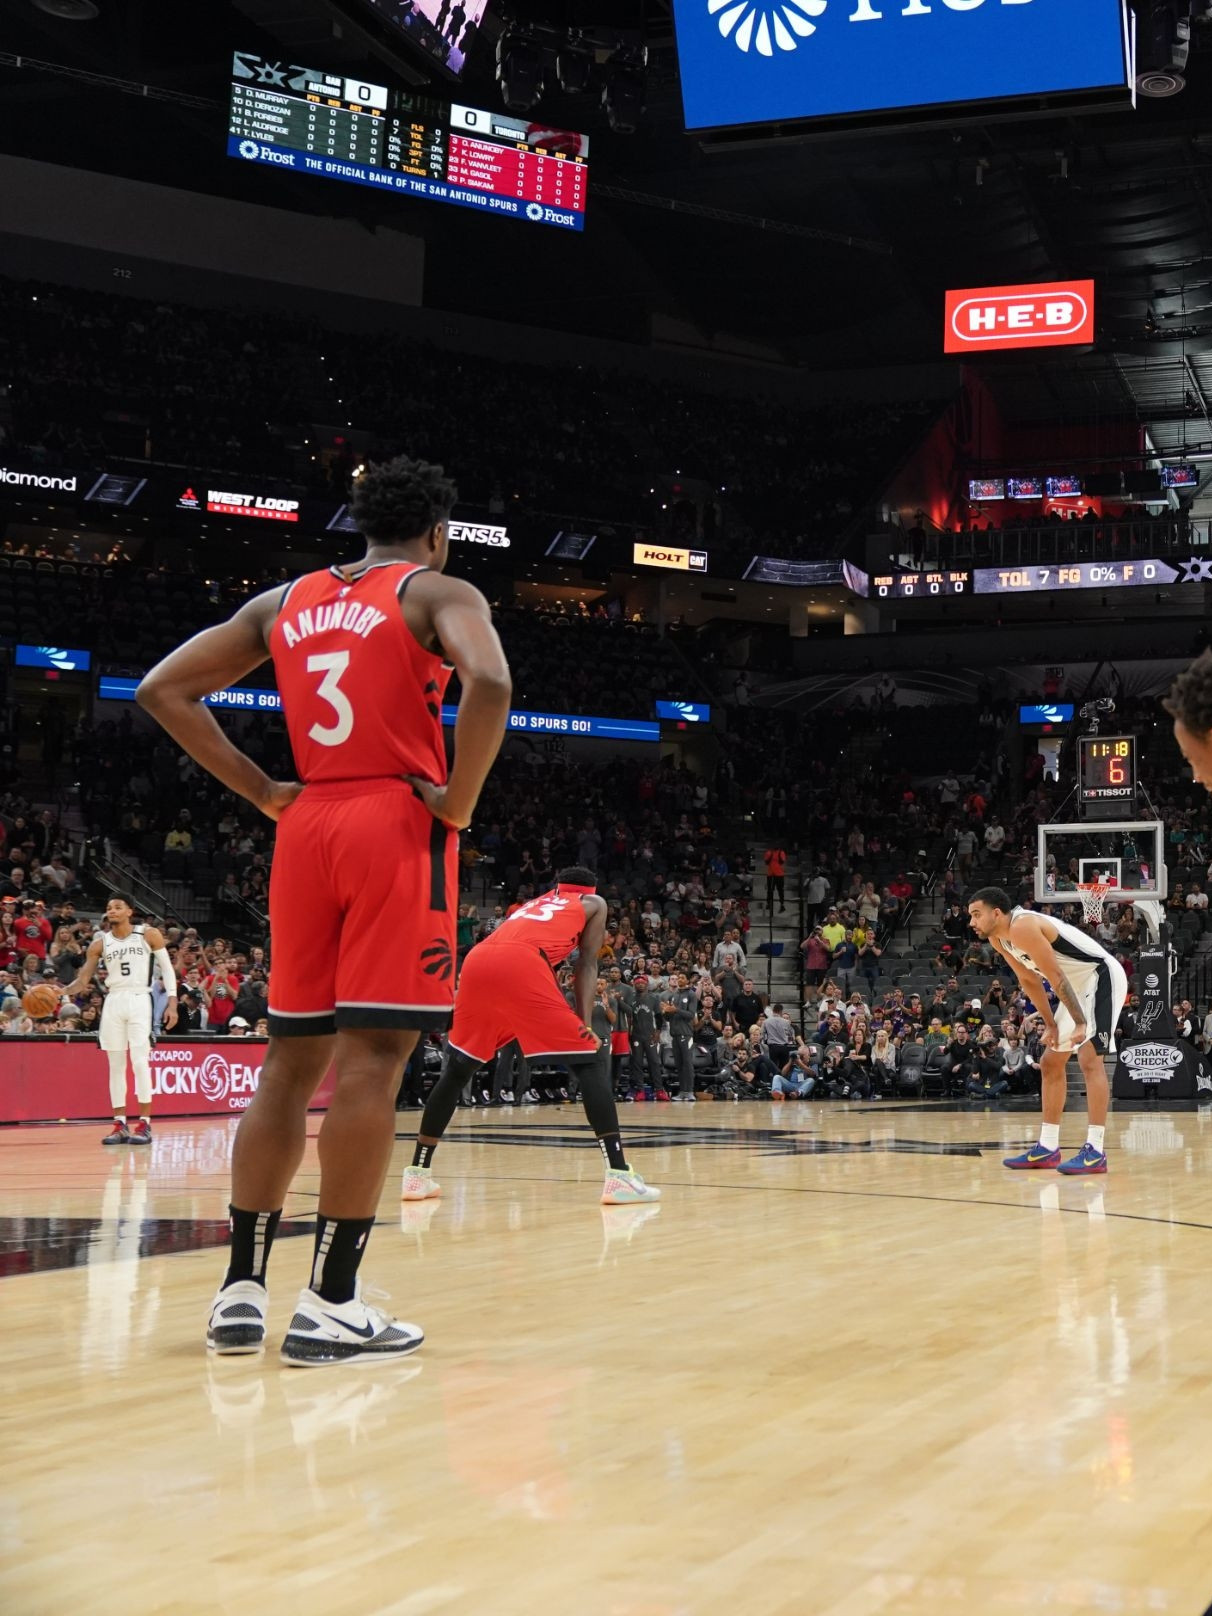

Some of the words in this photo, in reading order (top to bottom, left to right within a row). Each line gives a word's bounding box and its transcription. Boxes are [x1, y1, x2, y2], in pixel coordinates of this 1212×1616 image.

[358, 86, 371, 100] 0
[464, 110, 477, 126] 0
[260, 146, 295, 166] Frost
[306, 158, 322, 170] THE
[326, 162, 366, 180] OFFICIAL
[369, 172, 393, 186] BANK
[396, 178, 408, 188] OF
[410, 180, 426, 192] THE
[430, 186, 446, 196] SAN
[450, 190, 486, 205] ANTONIO
[490, 199, 518, 212] SPURS
[544, 208, 574, 226] Frost
[968, 302, 1073, 331] H-E-B
[0, 467, 76, 492] iamond
[208, 490, 254, 507] WEST
[255, 496, 299, 512] LOOP
[644, 550, 685, 562] HOLT
[690, 555, 706, 567] CAT
[874, 576, 892, 586] REB
[900, 575, 919, 584] AST
[926, 574, 944, 582] STL
[950, 572, 968, 582] BLK
[999, 572, 1031, 587] TOL
[1040, 570, 1050, 584] 7
[1058, 568, 1080, 584] FG
[1090, 567, 1116, 582] 0%
[1124, 566, 1134, 580] F
[1144, 564, 1156, 578] 0
[879, 586, 888, 596] 0
[904, 584, 914, 595] 0
[930, 583, 939, 594] 0
[954, 582, 964, 592] 0
[282, 600, 388, 648] ANUNOBY
[210, 691, 254, 705] SPURS
[258, 694, 280, 707] GO!
[306, 650, 354, 746] 3
[510, 715, 526, 727] GO
[530, 716, 568, 730] SPURS
[572, 720, 591, 732] GO!
[1093, 742, 1128, 757] 11:18
[1110, 758, 1124, 784] 6
[1096, 788, 1132, 796] TISSOT
[106, 946, 144, 962] SPURS
[120, 962, 130, 976] 5
[149, 1050, 193, 1062] ICKAPOO
[1134, 1048, 1170, 1056] BRAKE
[1134, 1057, 1169, 1066] CHECK
